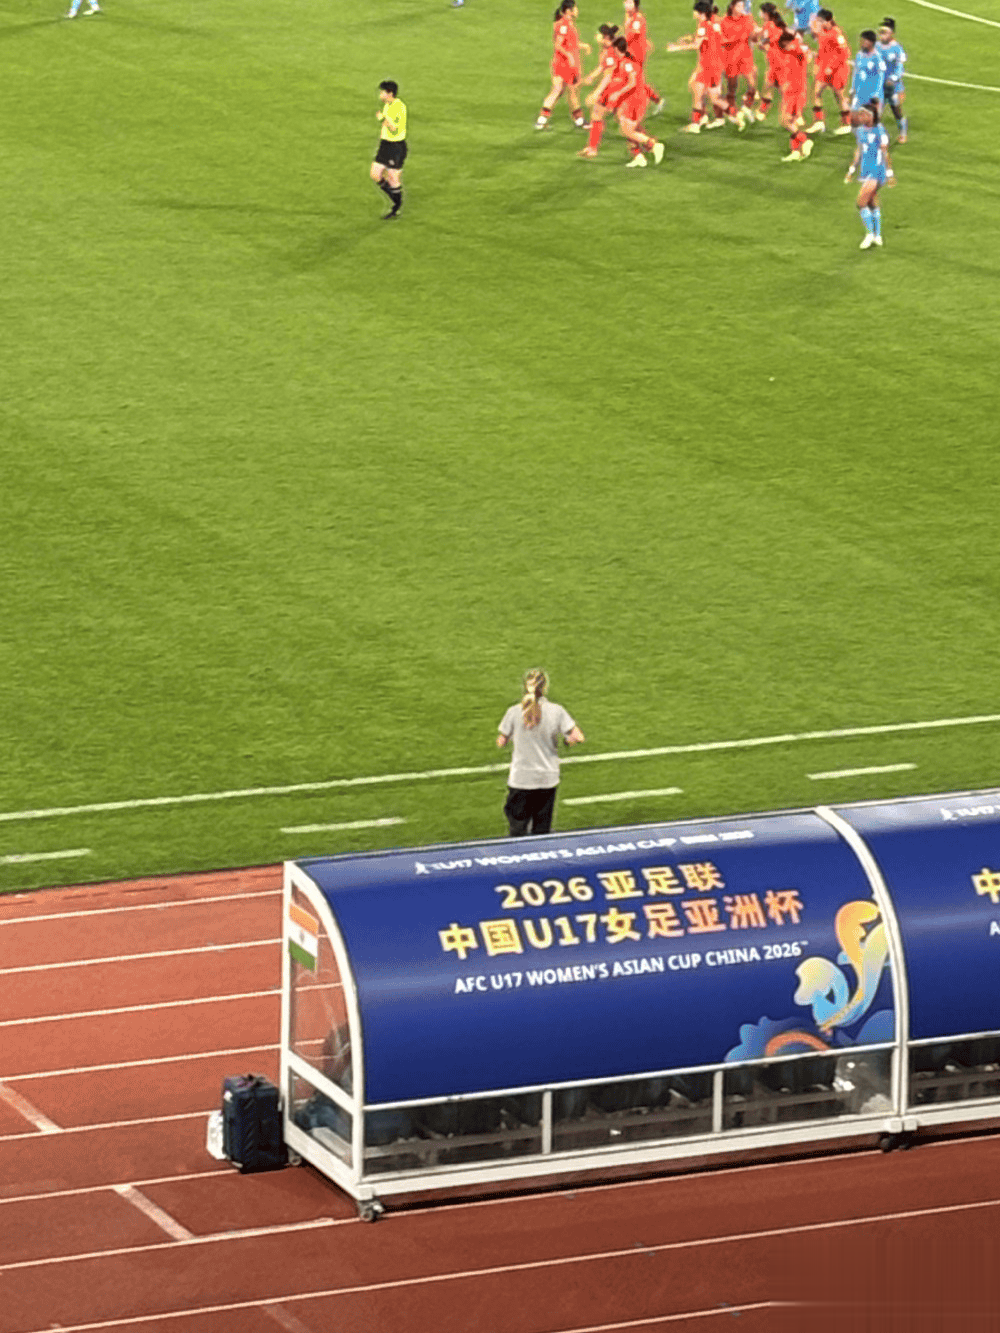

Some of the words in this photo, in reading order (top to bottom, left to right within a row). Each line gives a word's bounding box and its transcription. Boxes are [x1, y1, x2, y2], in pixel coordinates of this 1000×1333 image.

[494, 876, 594, 909] 2026
[596, 862, 726, 901] 亚足联
[437, 890, 804, 961] 中国U17女足亚洲杯
[454, 975, 488, 995] AFC
[490, 972, 523, 990] U17
[526, 962, 610, 987] WOMEN'S
[612, 956, 665, 978] ASIAN
[668, 953, 702, 971] CUP
[705, 947, 761, 967] CHINA
